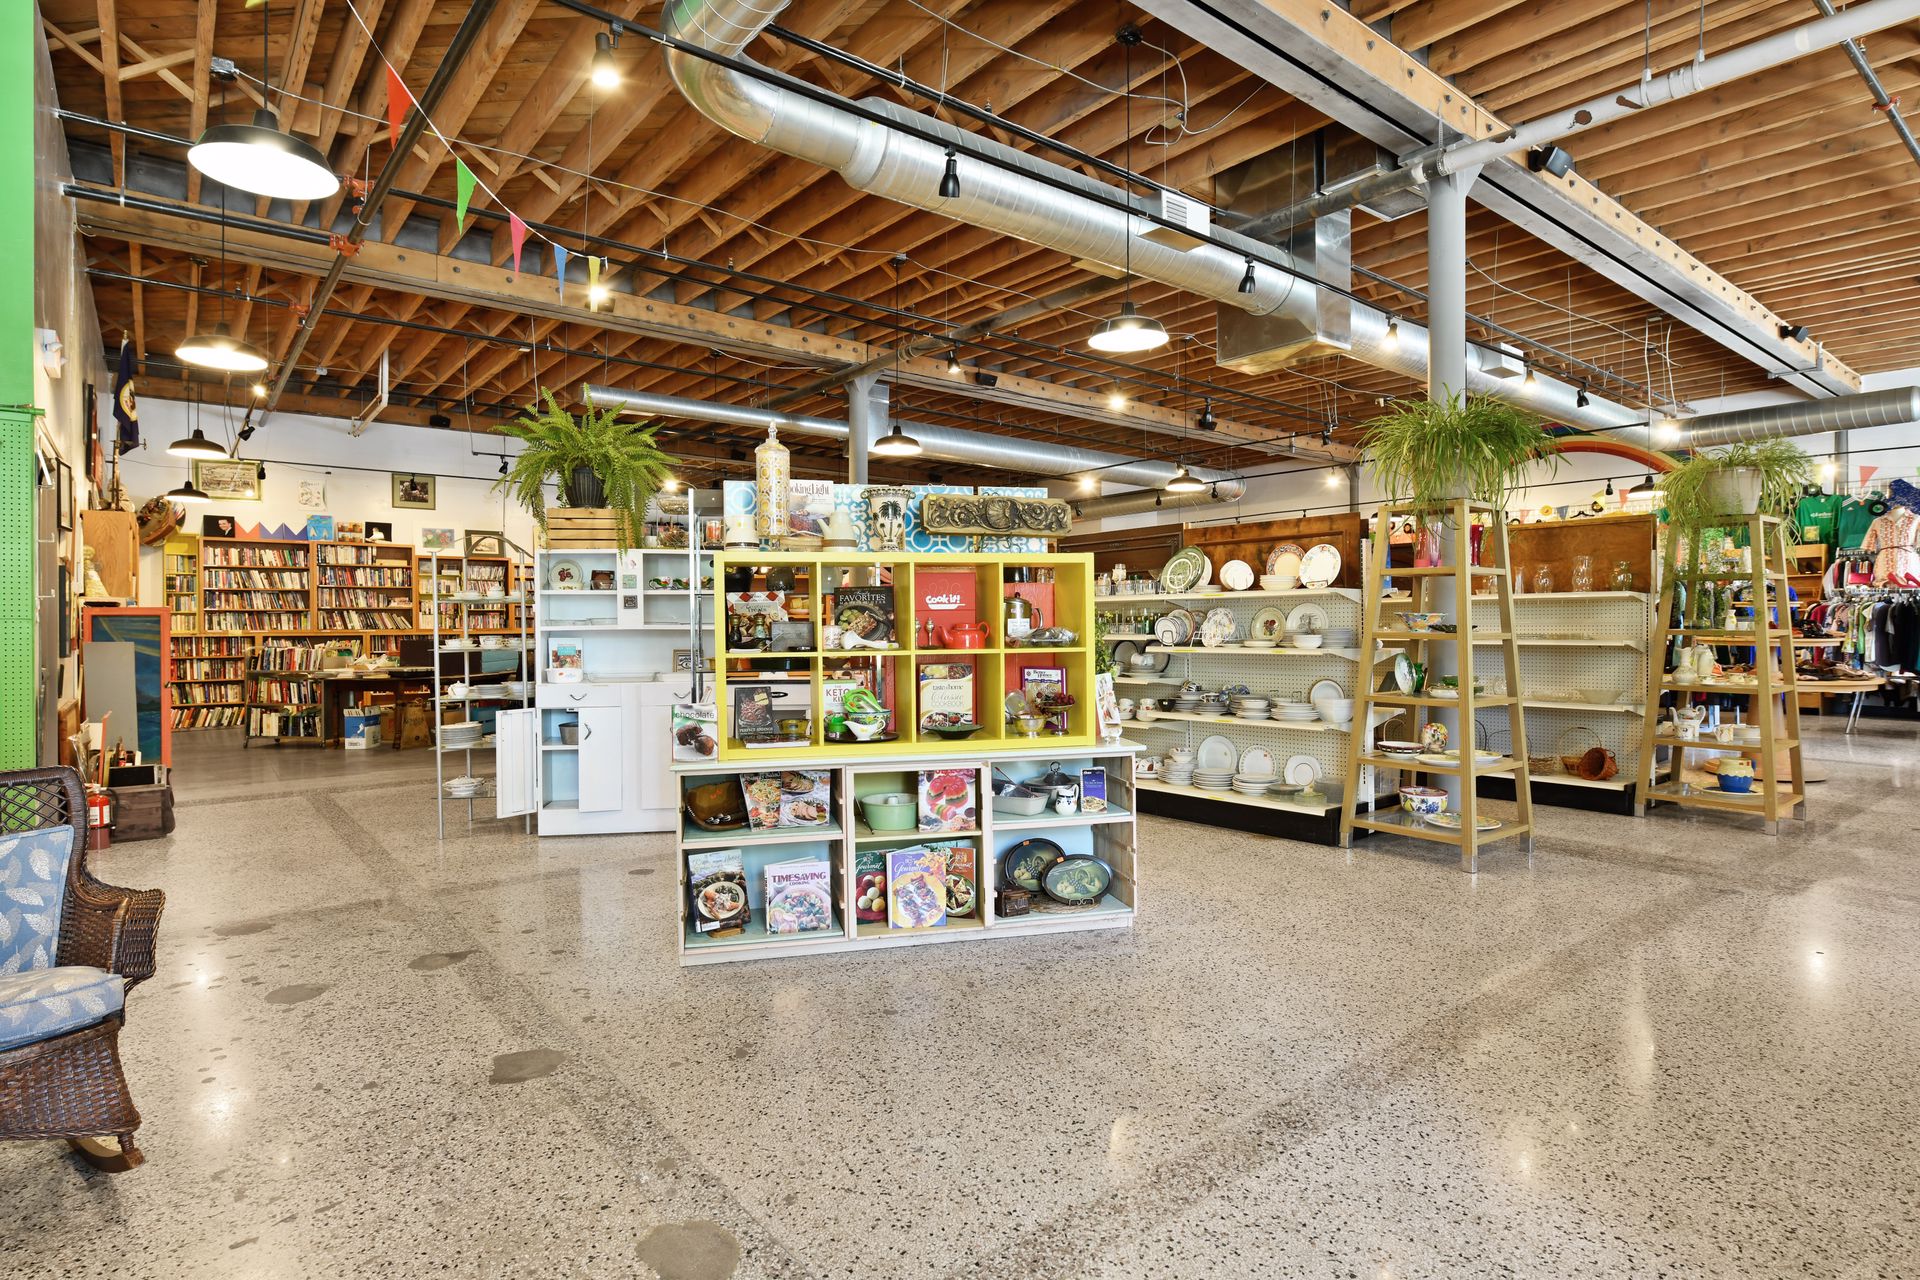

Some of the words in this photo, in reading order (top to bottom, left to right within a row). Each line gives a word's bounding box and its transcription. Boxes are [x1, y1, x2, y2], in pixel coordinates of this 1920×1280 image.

[839, 593, 886, 603] FAVORITES
[925, 594, 949, 604] Cook
[675, 711, 715, 719] chocolate
[771, 871, 827, 883] TIMESAVING
